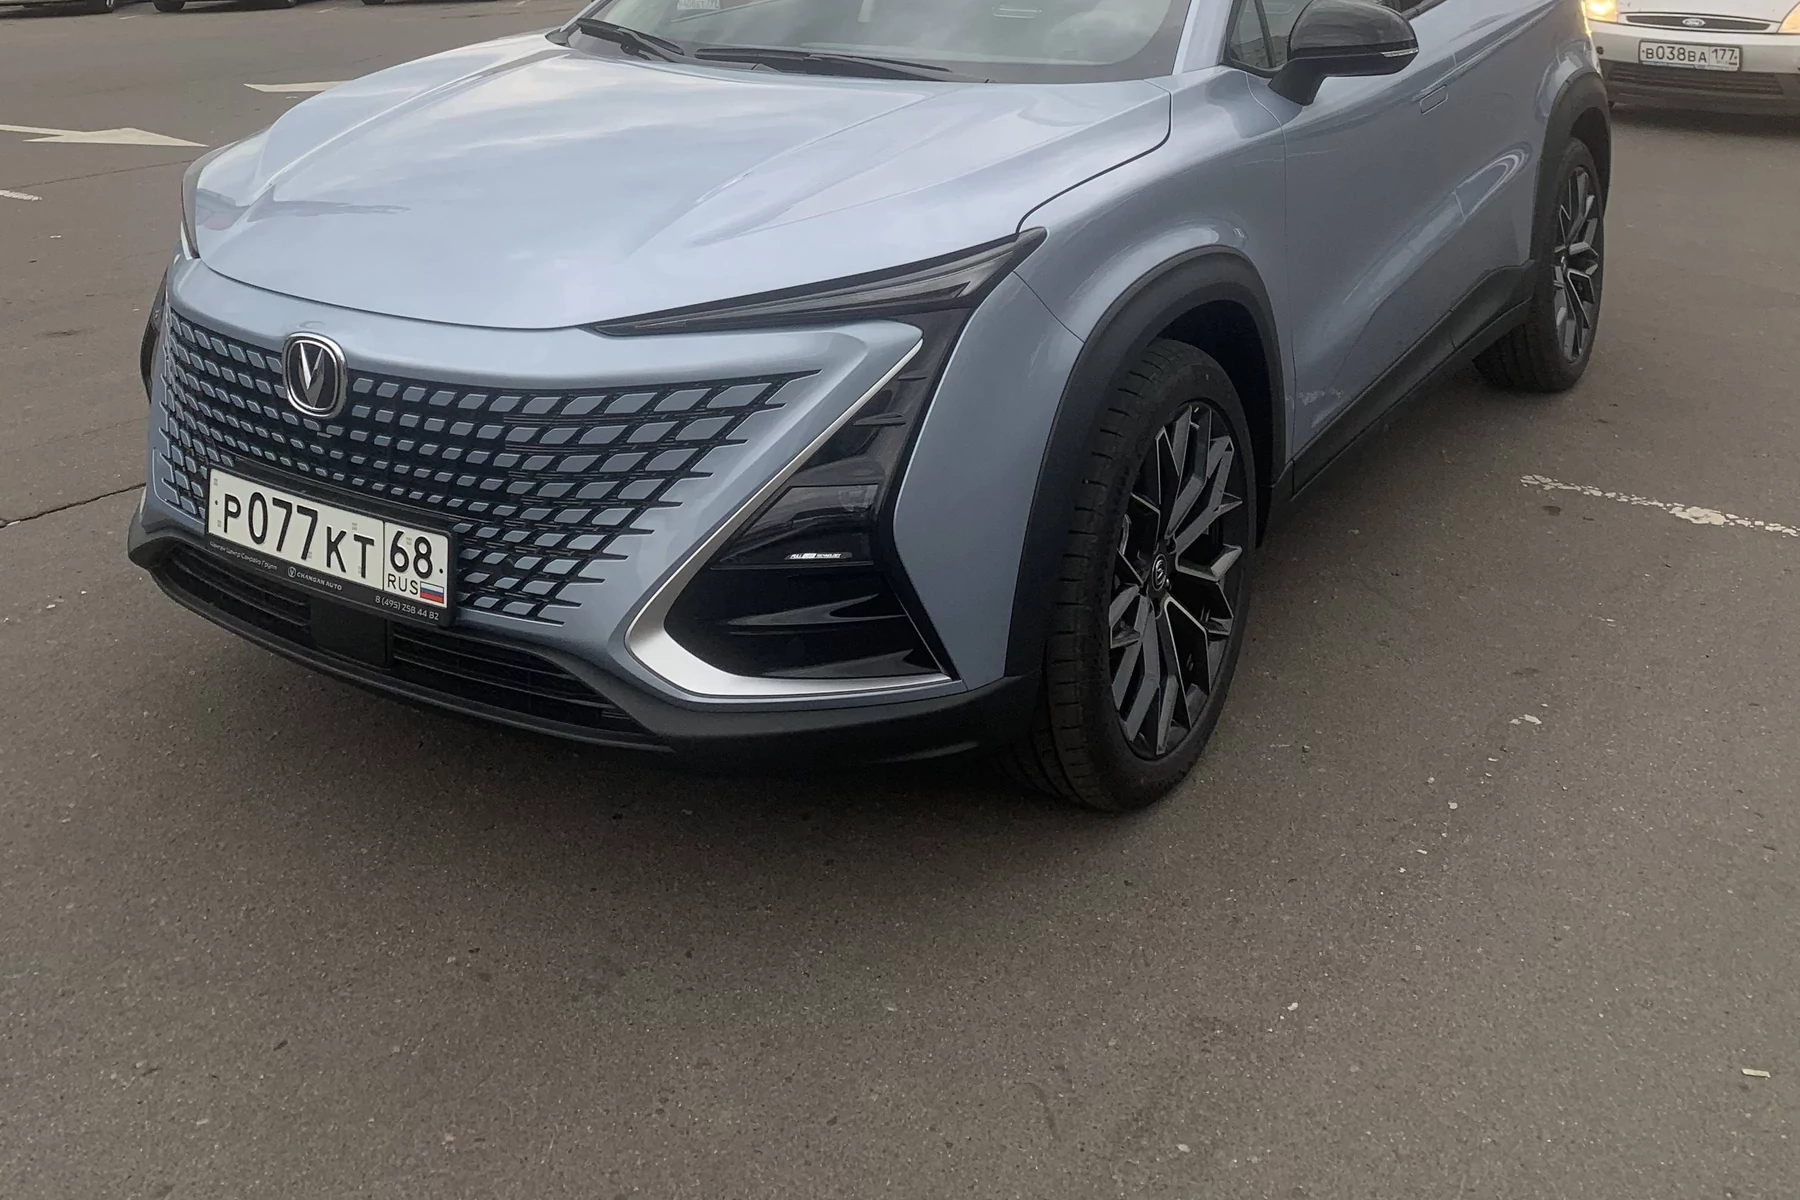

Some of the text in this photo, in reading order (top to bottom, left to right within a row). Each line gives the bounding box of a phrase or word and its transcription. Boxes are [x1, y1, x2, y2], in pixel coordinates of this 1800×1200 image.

[1645, 45, 1736, 63] В038ВА 177
[223, 491, 433, 580] Р077КТ 68
[296, 571, 343, 591] CHANGAN AUTO
[387, 573, 419, 596] RUS
[381, 597, 401, 611] (495)
[401, 603, 417, 615] 258
[417, 608, 428, 618] 44
[428, 611, 440, 621] 82
